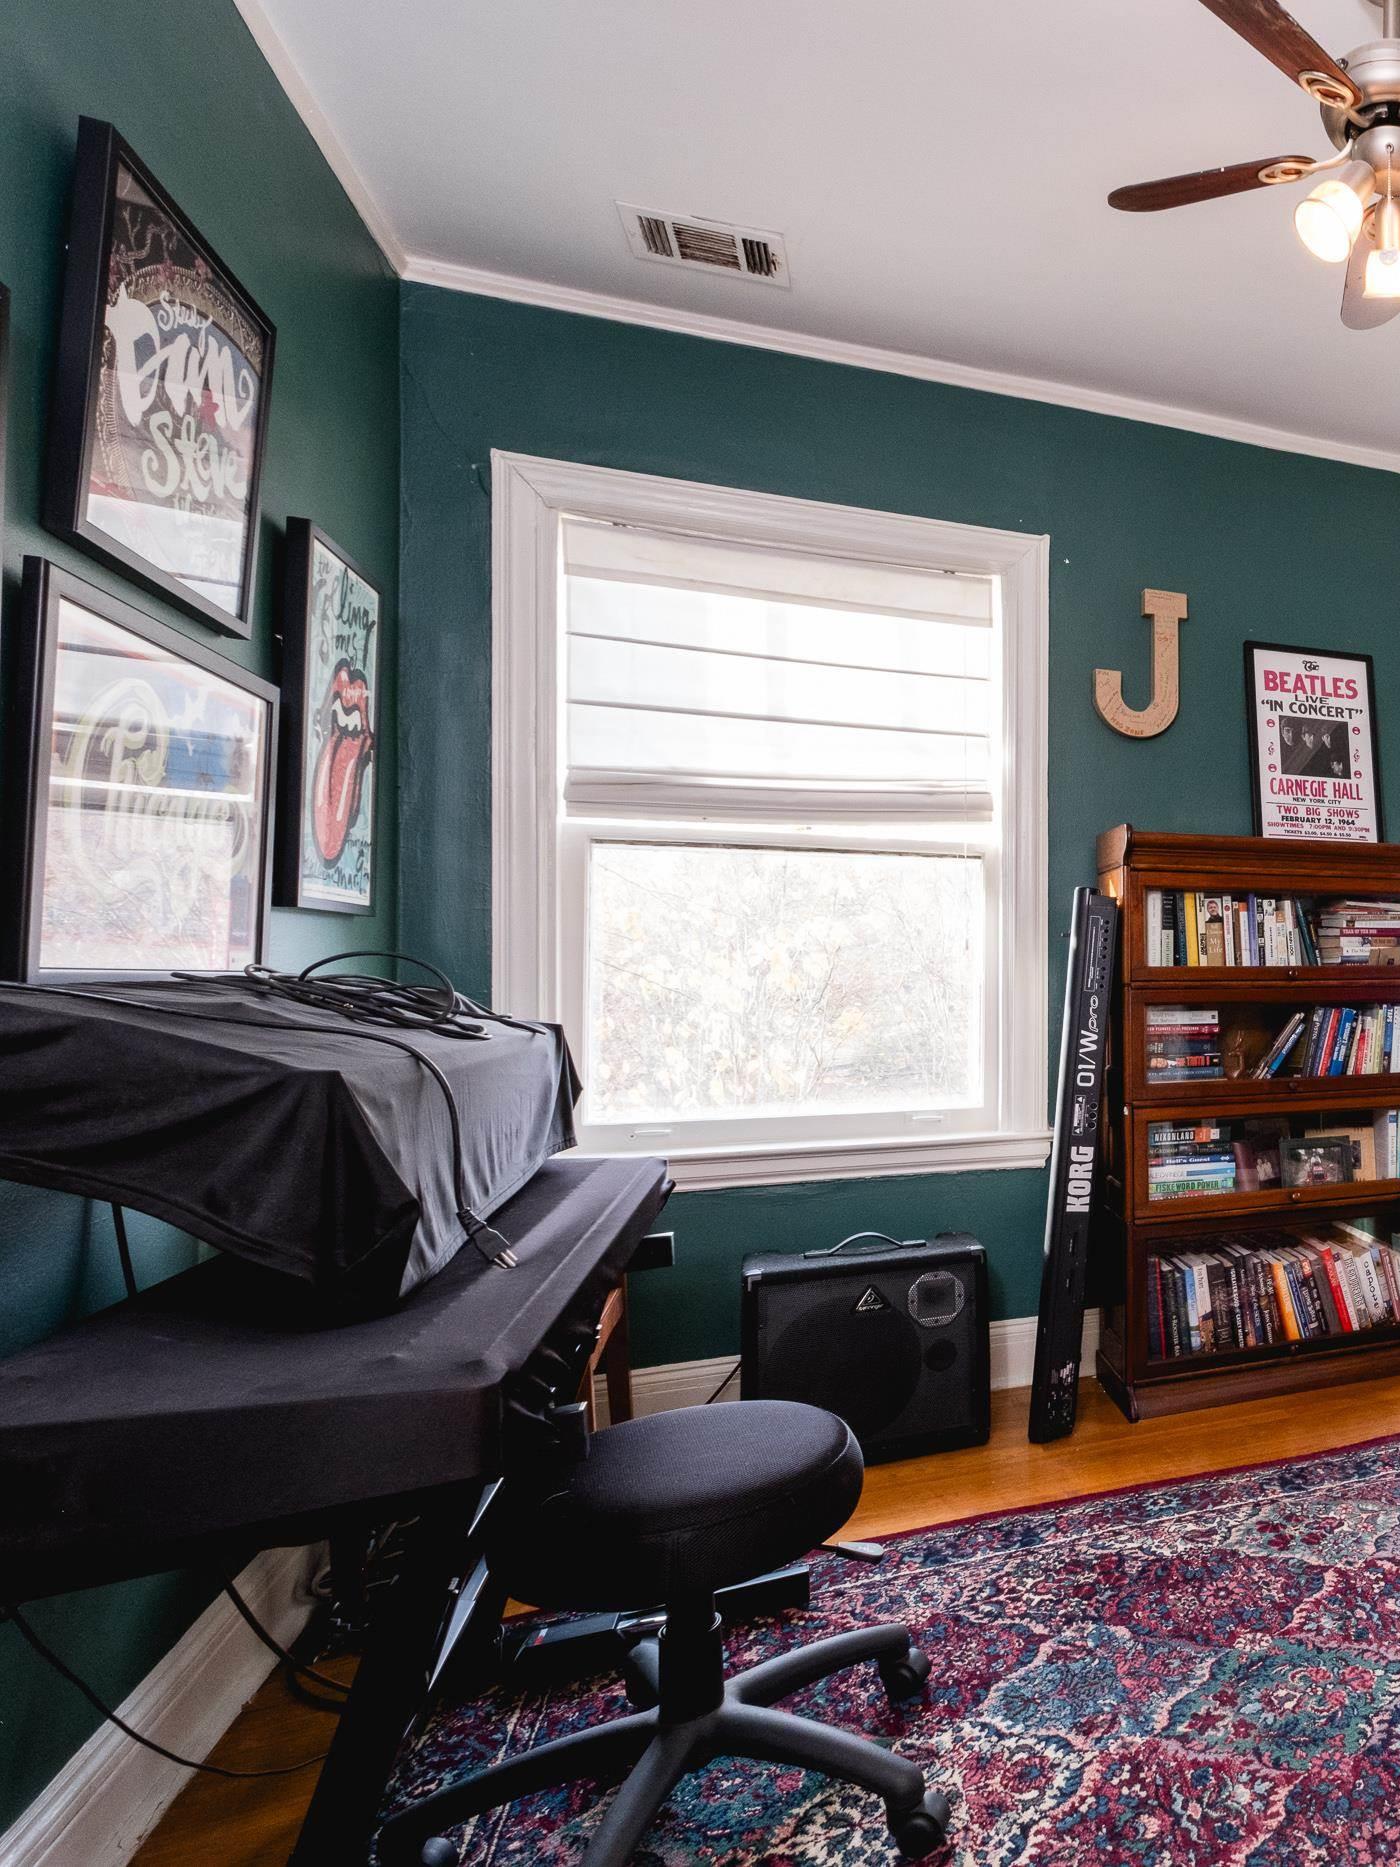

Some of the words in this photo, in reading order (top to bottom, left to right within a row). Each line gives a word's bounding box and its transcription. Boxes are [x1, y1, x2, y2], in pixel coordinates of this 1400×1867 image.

[1093, 588, 1189, 738] J
[1302, 659, 1320, 672] The
[1263, 670, 1359, 700] BEATLES
[1294, 694, 1330, 705] LIVE
[1269, 777, 1328, 798] CARNEGIE
[1332, 783, 1363, 801] HALL
[1276, 805, 1299, 815] TWO
[1305, 808, 1321, 816] BIG
[1327, 809, 1360, 819] SHOWS
[1267, 821, 1304, 829] SHOWTIMES
[1281, 815, 1322, 824] FEBRUARY
[1154, 1131, 1195, 1142] NIXONLAND
[1065, 1146, 1094, 1213] KORG
[1155, 1183, 1176, 1193] FISKE
[1176, 1182, 1196, 1191] WORD
[1197, 1180, 1219, 1190] POWER
